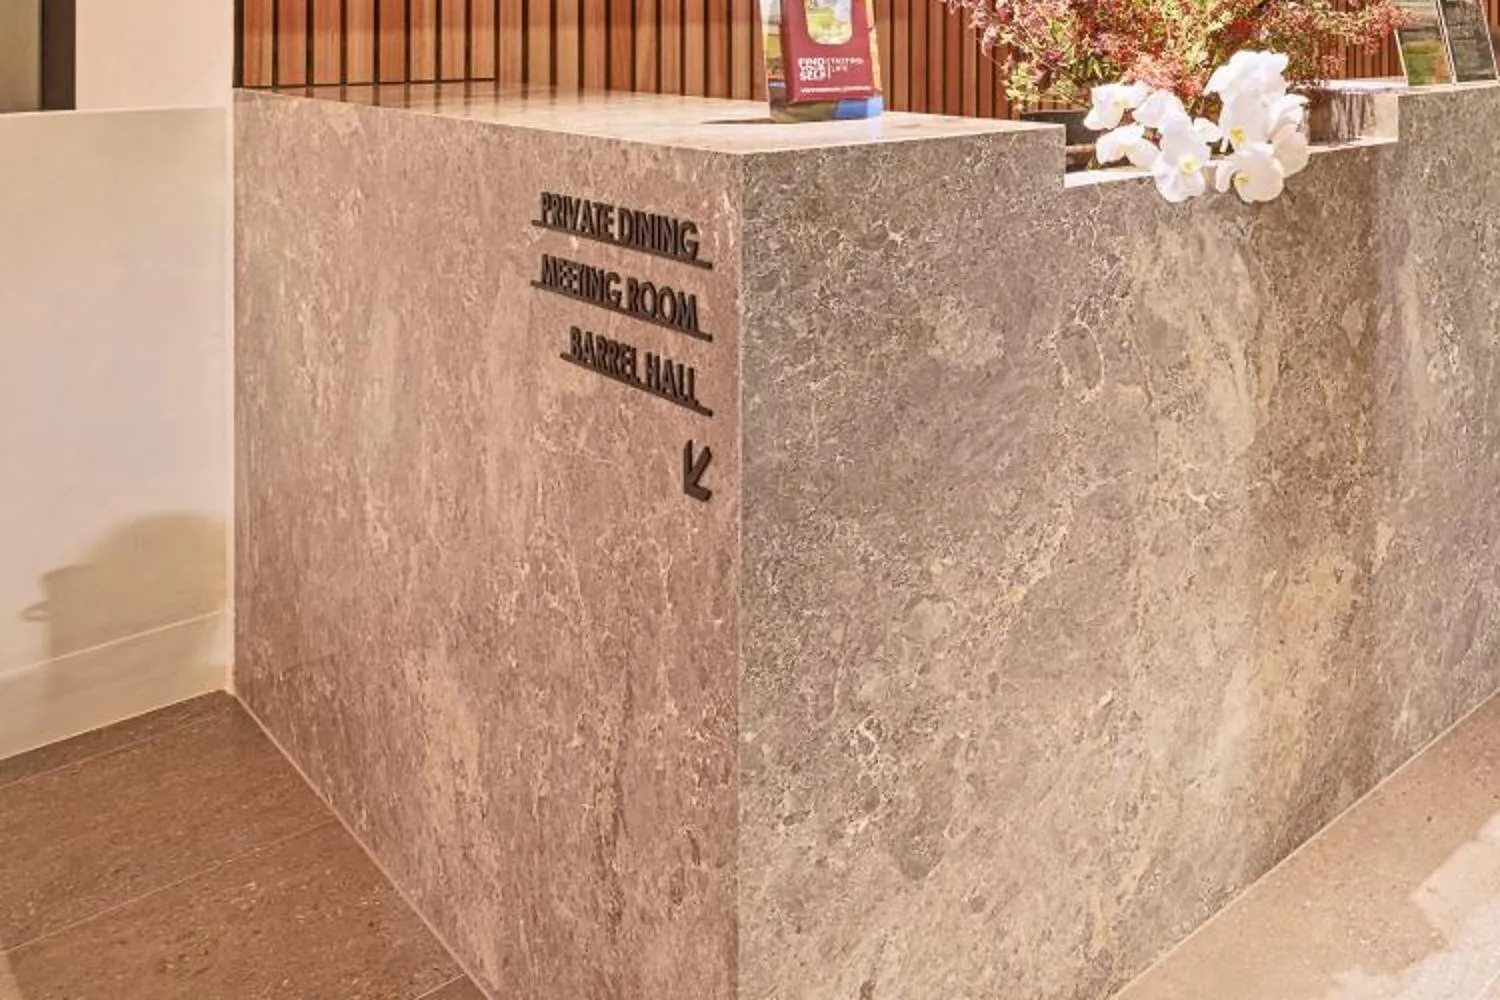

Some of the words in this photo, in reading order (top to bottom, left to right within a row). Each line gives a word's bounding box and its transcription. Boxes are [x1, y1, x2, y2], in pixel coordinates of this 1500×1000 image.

[541, 192, 615, 242] PRIVATE
[618, 207, 699, 261] DINING
[541, 254, 622, 308] MEETING
[626, 277, 699, 332] ROOM
[570, 325, 641, 383] BARREL
[645, 351, 699, 406] HALL
